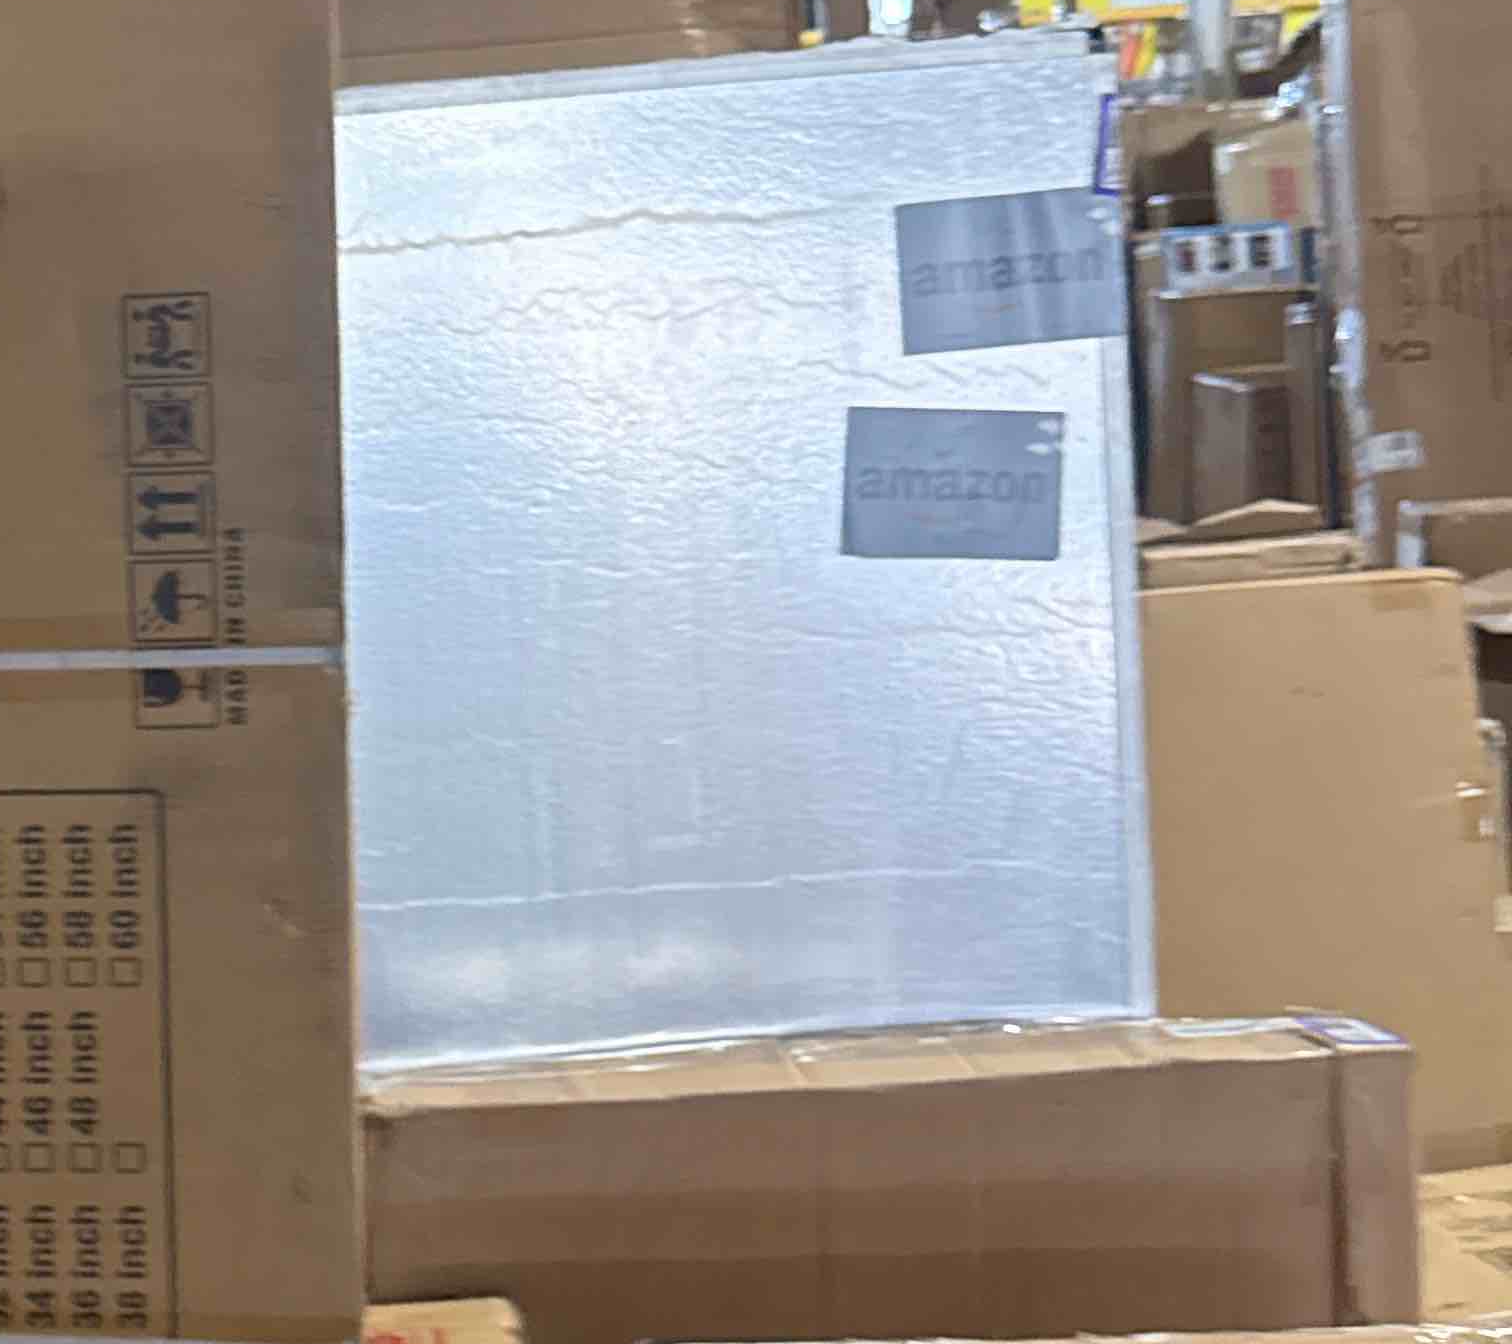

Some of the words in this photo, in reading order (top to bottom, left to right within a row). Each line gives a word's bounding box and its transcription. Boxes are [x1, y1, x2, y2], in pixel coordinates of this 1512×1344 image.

[858, 464, 1048, 505] amazon
[223, 528, 247, 608] CHINA
[226, 617, 247, 645] IN
[224, 654, 248, 725] MAD
[15, 825, 48, 899] inch
[61, 823, 94, 898] inch
[107, 823, 141, 898] inch
[108, 909, 141, 949] 60
[19, 1011, 54, 1085] inch
[65, 1011, 99, 1085] inch
[24, 1204, 57, 1278] inch
[68, 1205, 101, 1279] inch
[113, 1205, 147, 1279] inch
[24, 1290, 57, 1329] 34
